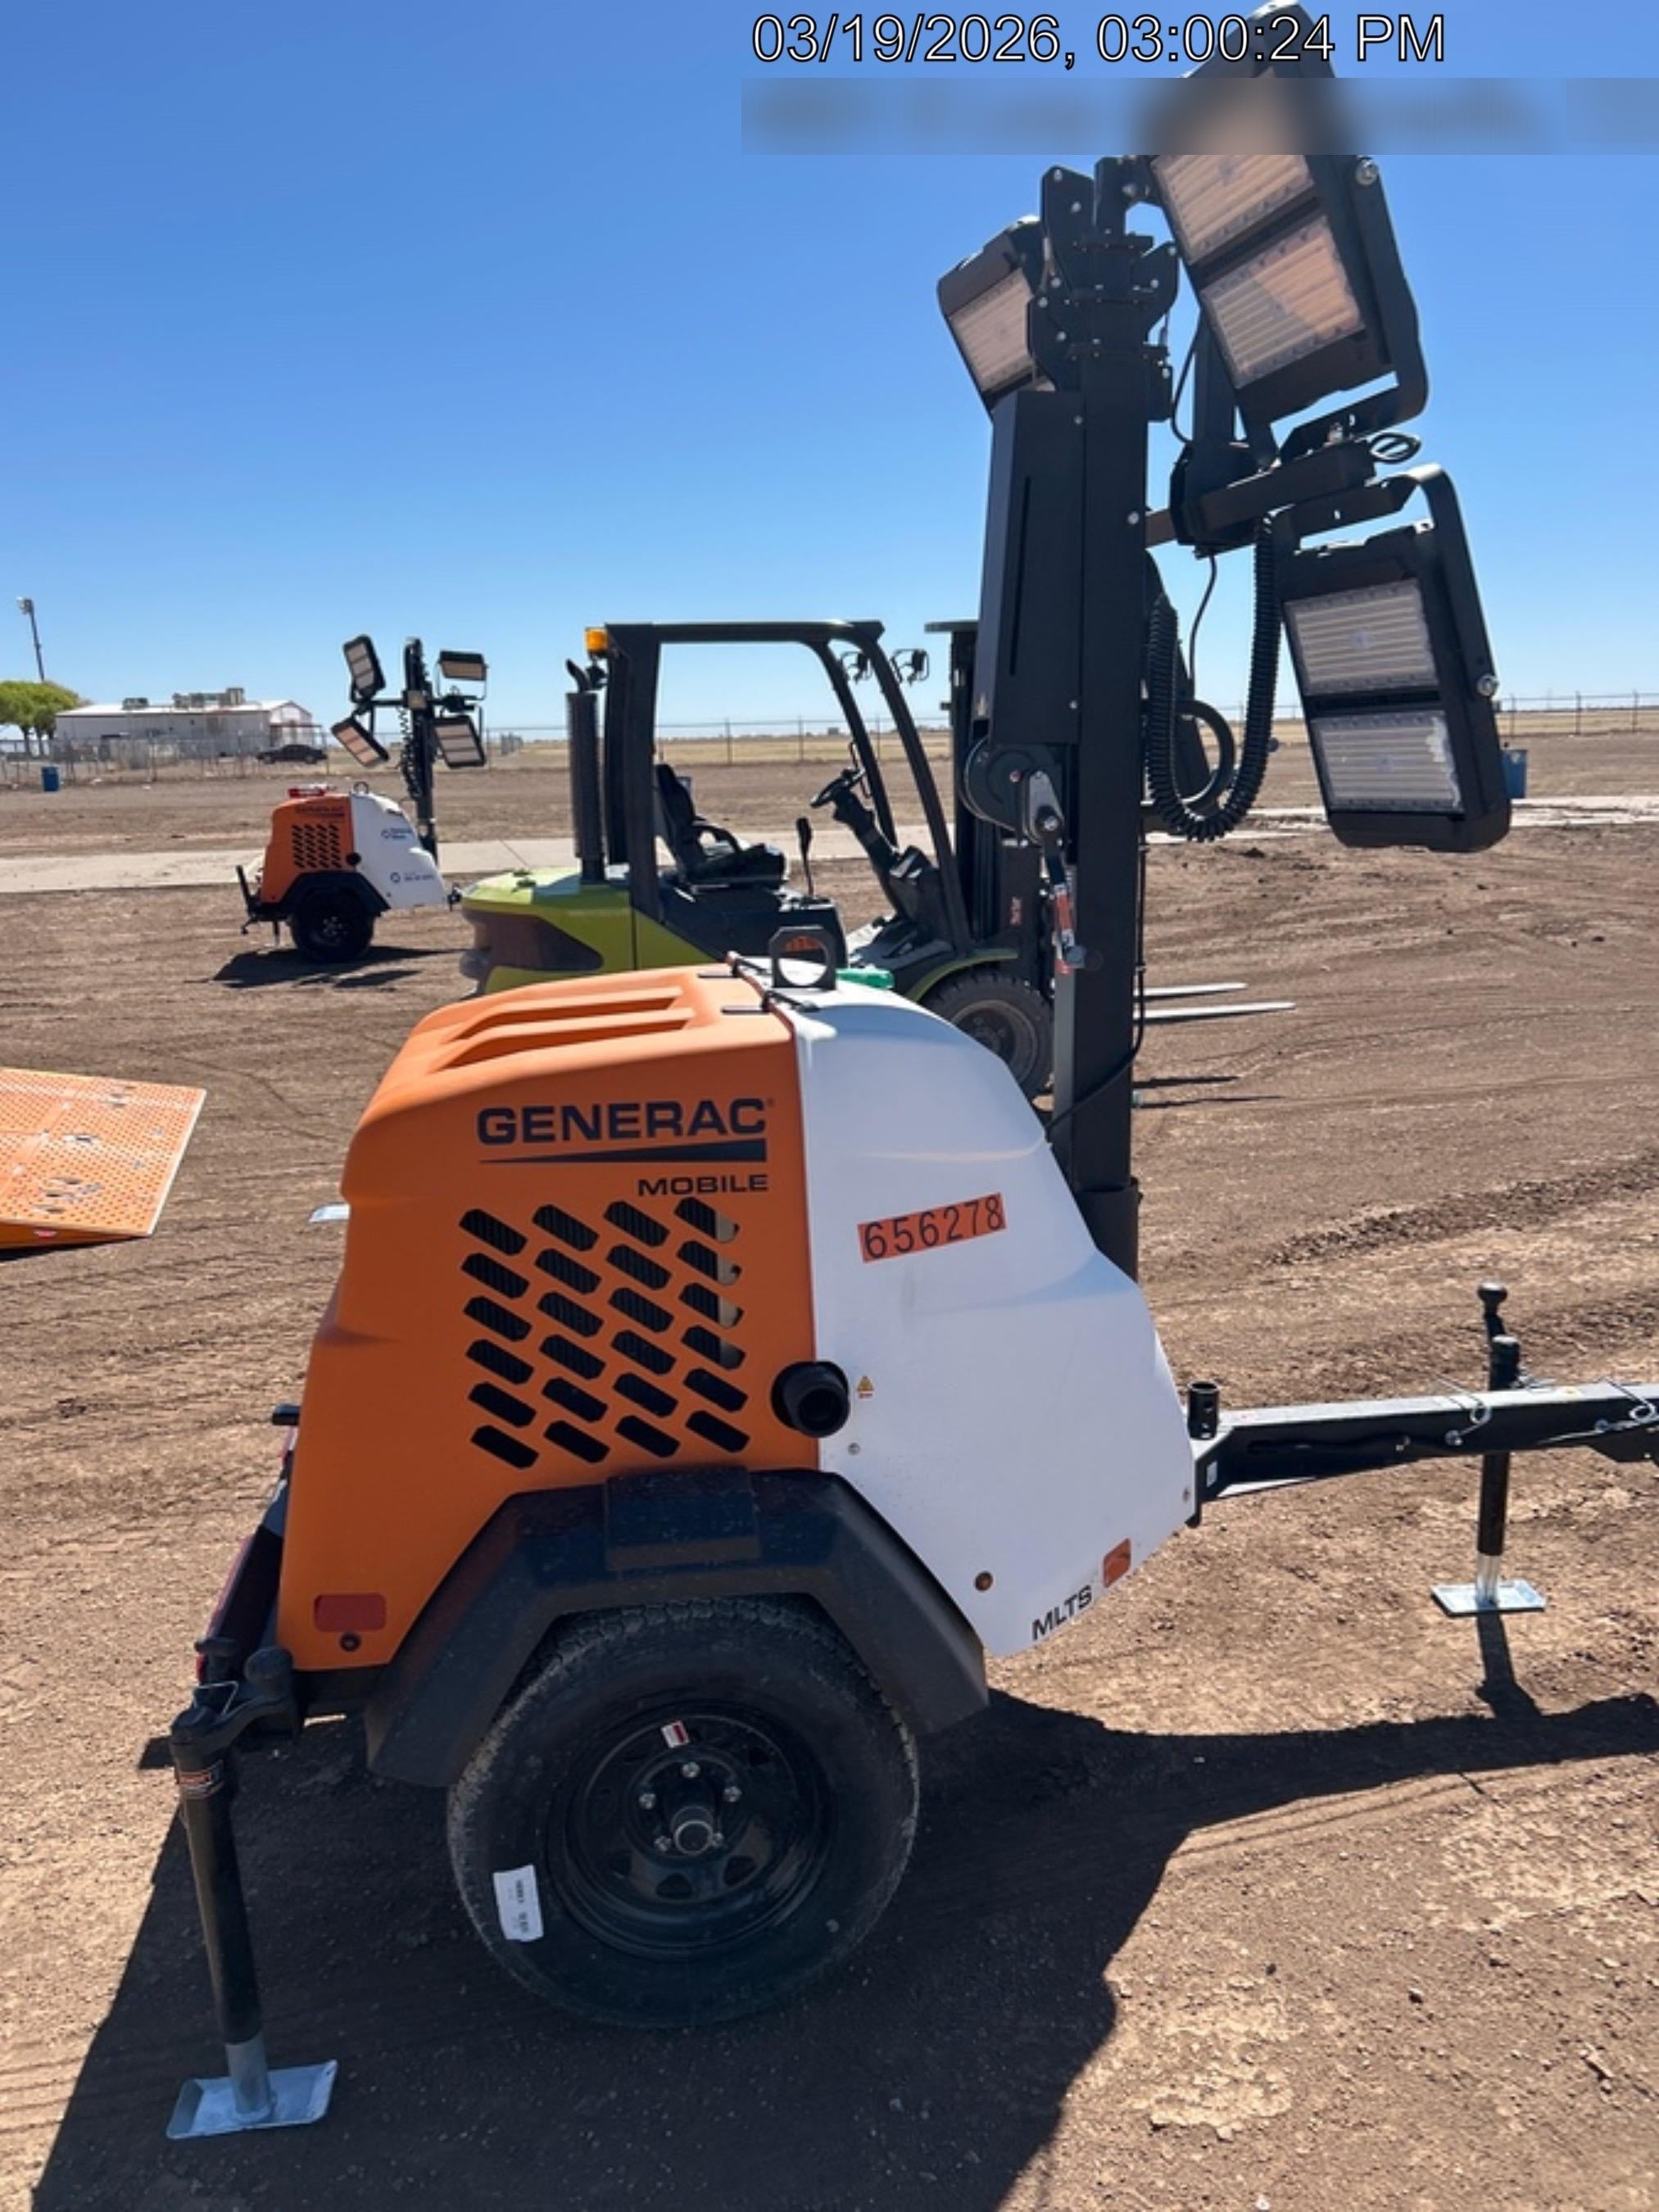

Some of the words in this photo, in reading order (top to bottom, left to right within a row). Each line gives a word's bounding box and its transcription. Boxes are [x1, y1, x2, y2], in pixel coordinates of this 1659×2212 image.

[477, 1098, 765, 1145] GENERAC
[638, 1174, 768, 1197] MOBILE
[864, 1195, 1001, 1259] 656278
[1031, 1584, 1092, 1640] MLTS
